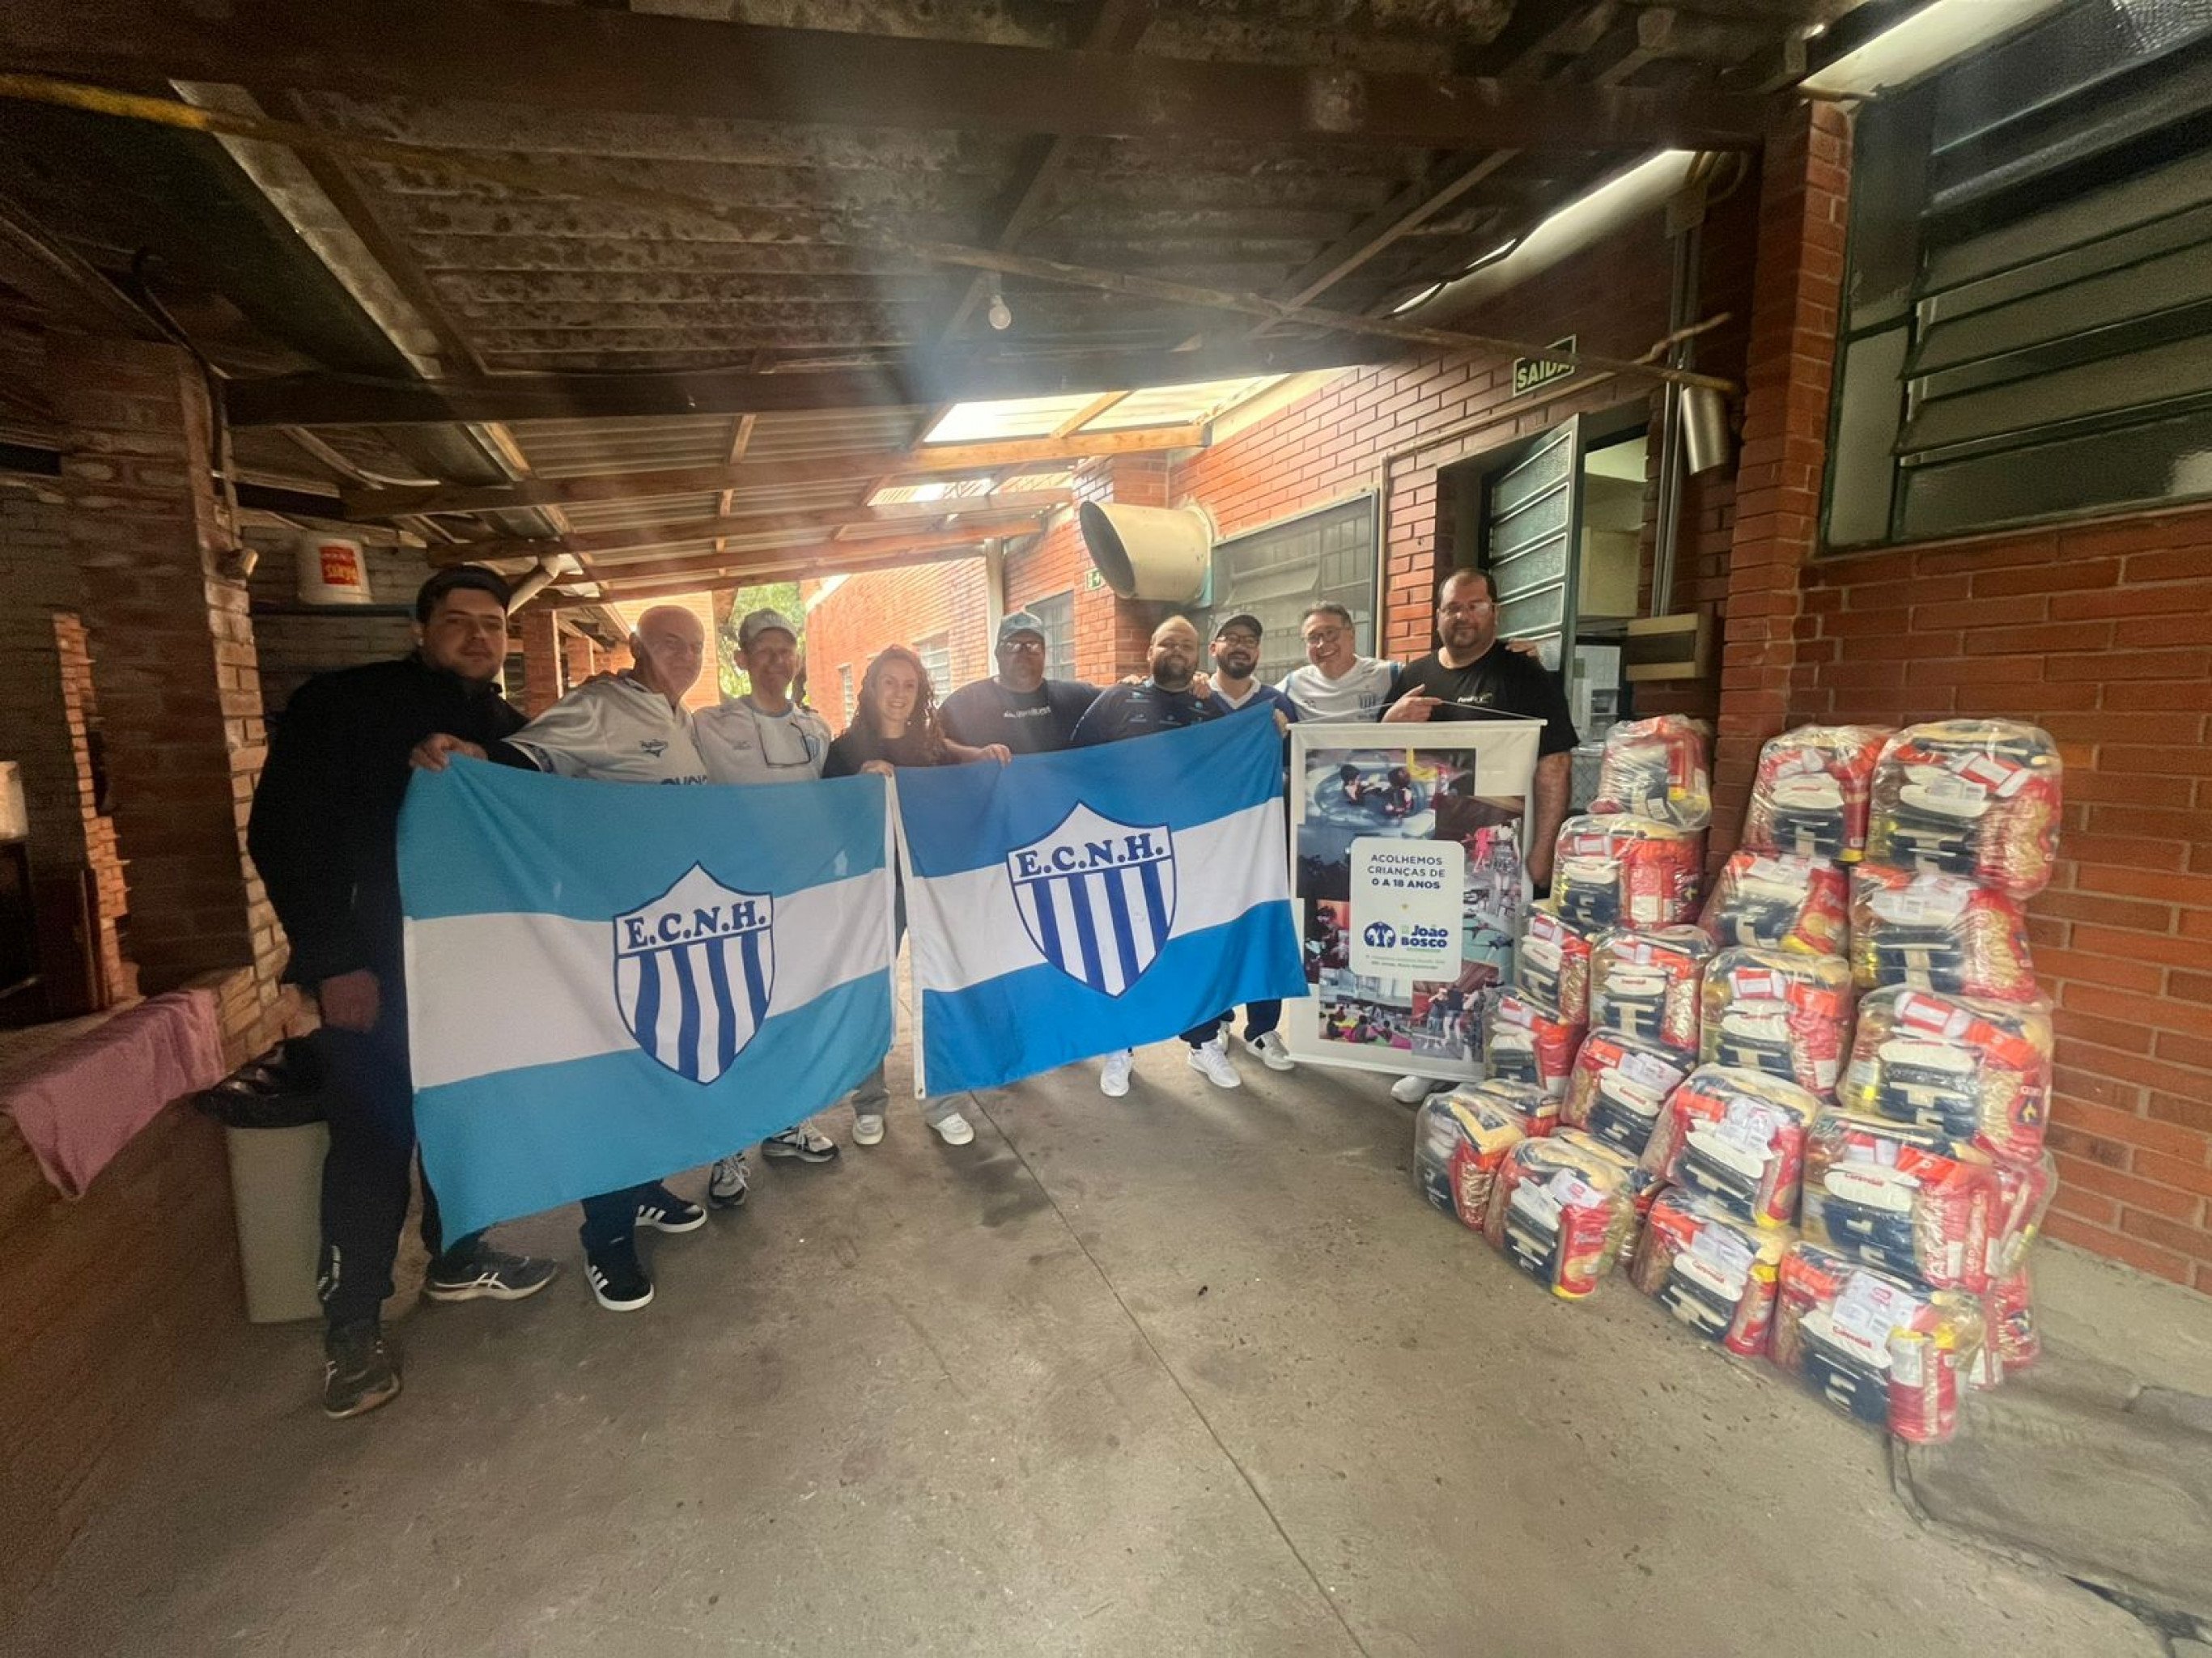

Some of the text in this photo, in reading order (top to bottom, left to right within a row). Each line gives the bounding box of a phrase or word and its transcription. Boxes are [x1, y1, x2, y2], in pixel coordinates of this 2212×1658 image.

[1016, 833, 1164, 878] E.C.N.H.
[1371, 854, 1443, 866] ACOLHEMOS
[1367, 866, 1446, 878] CRIANÇAS DE
[1382, 879, 1390, 887] A
[1393, 879, 1404, 888] 18
[1407, 880, 1441, 889] ANOS
[624, 901, 766, 949] E.C.N.H.
